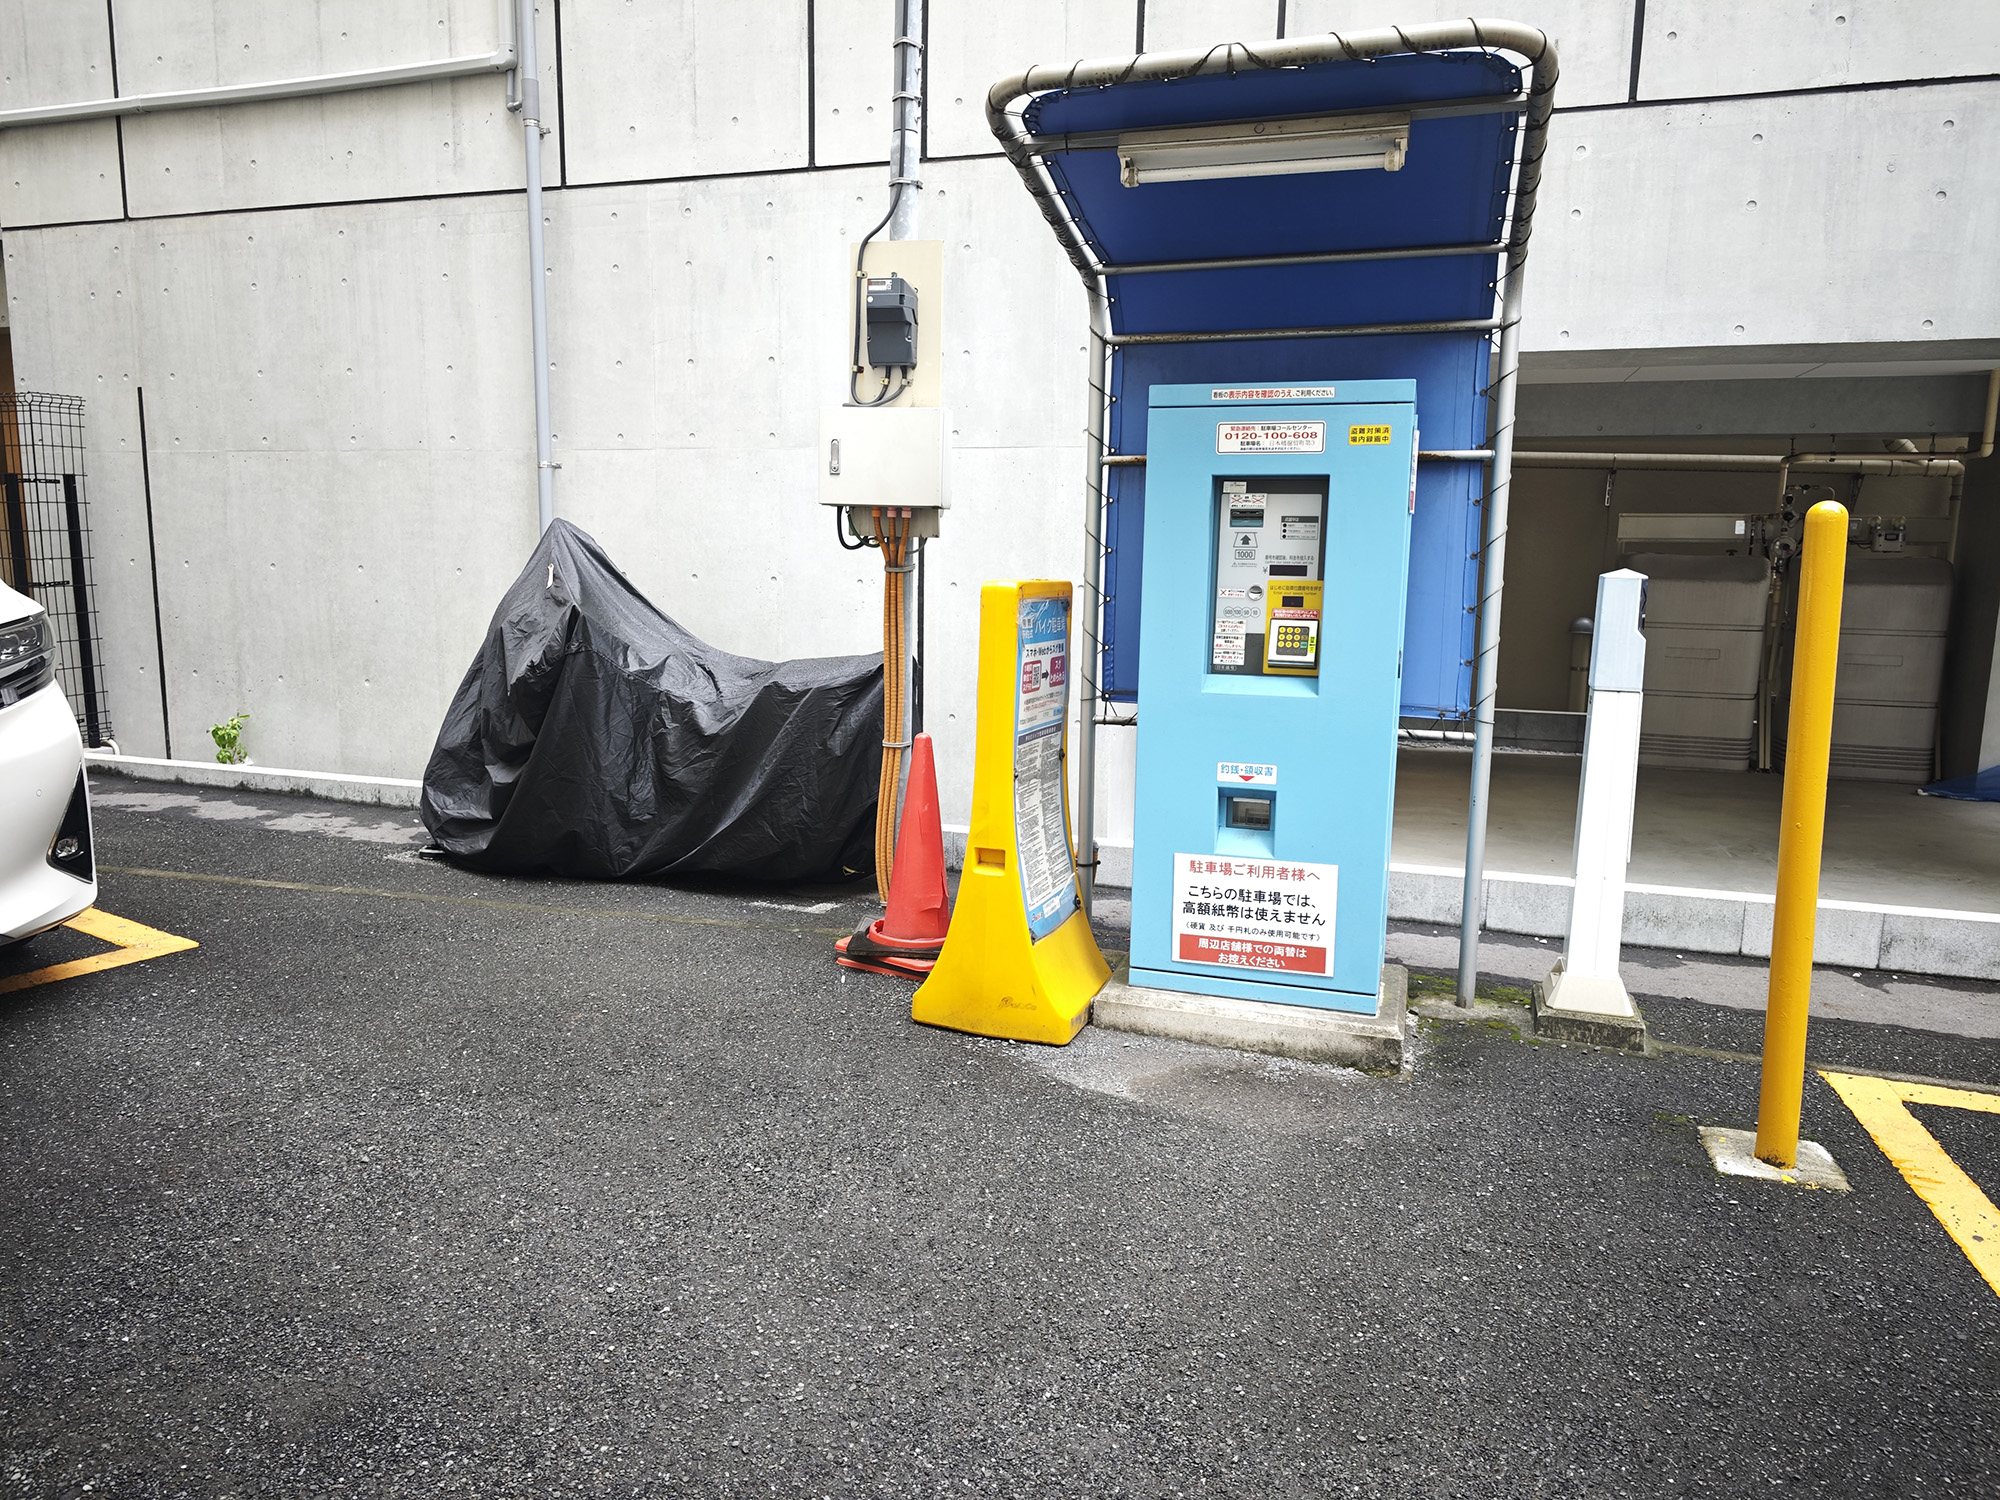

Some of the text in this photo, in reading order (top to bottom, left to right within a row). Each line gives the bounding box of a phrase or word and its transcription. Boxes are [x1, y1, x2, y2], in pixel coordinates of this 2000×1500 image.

[1224, 432, 1318, 440] 0120-100-608
[1350, 435, 1389, 443] 場内録画中
[1351, 427, 1389, 435] 盗難対策済
[1237, 550, 1253, 558] 1000
[1034, 615, 1066, 634] バイク駐車場
[1220, 764, 1274, 776] 釣銭・領収書
[1189, 859, 1320, 882] 駐車場ご利用者様へ
[1188, 885, 1318, 909] こちらの駐車場では、
[1182, 900, 1326, 926] 高額紙幣は使えません
[1198, 937, 1308, 958] 周辺店舗様での両替は
[1218, 952, 1286, 968] お控えください
